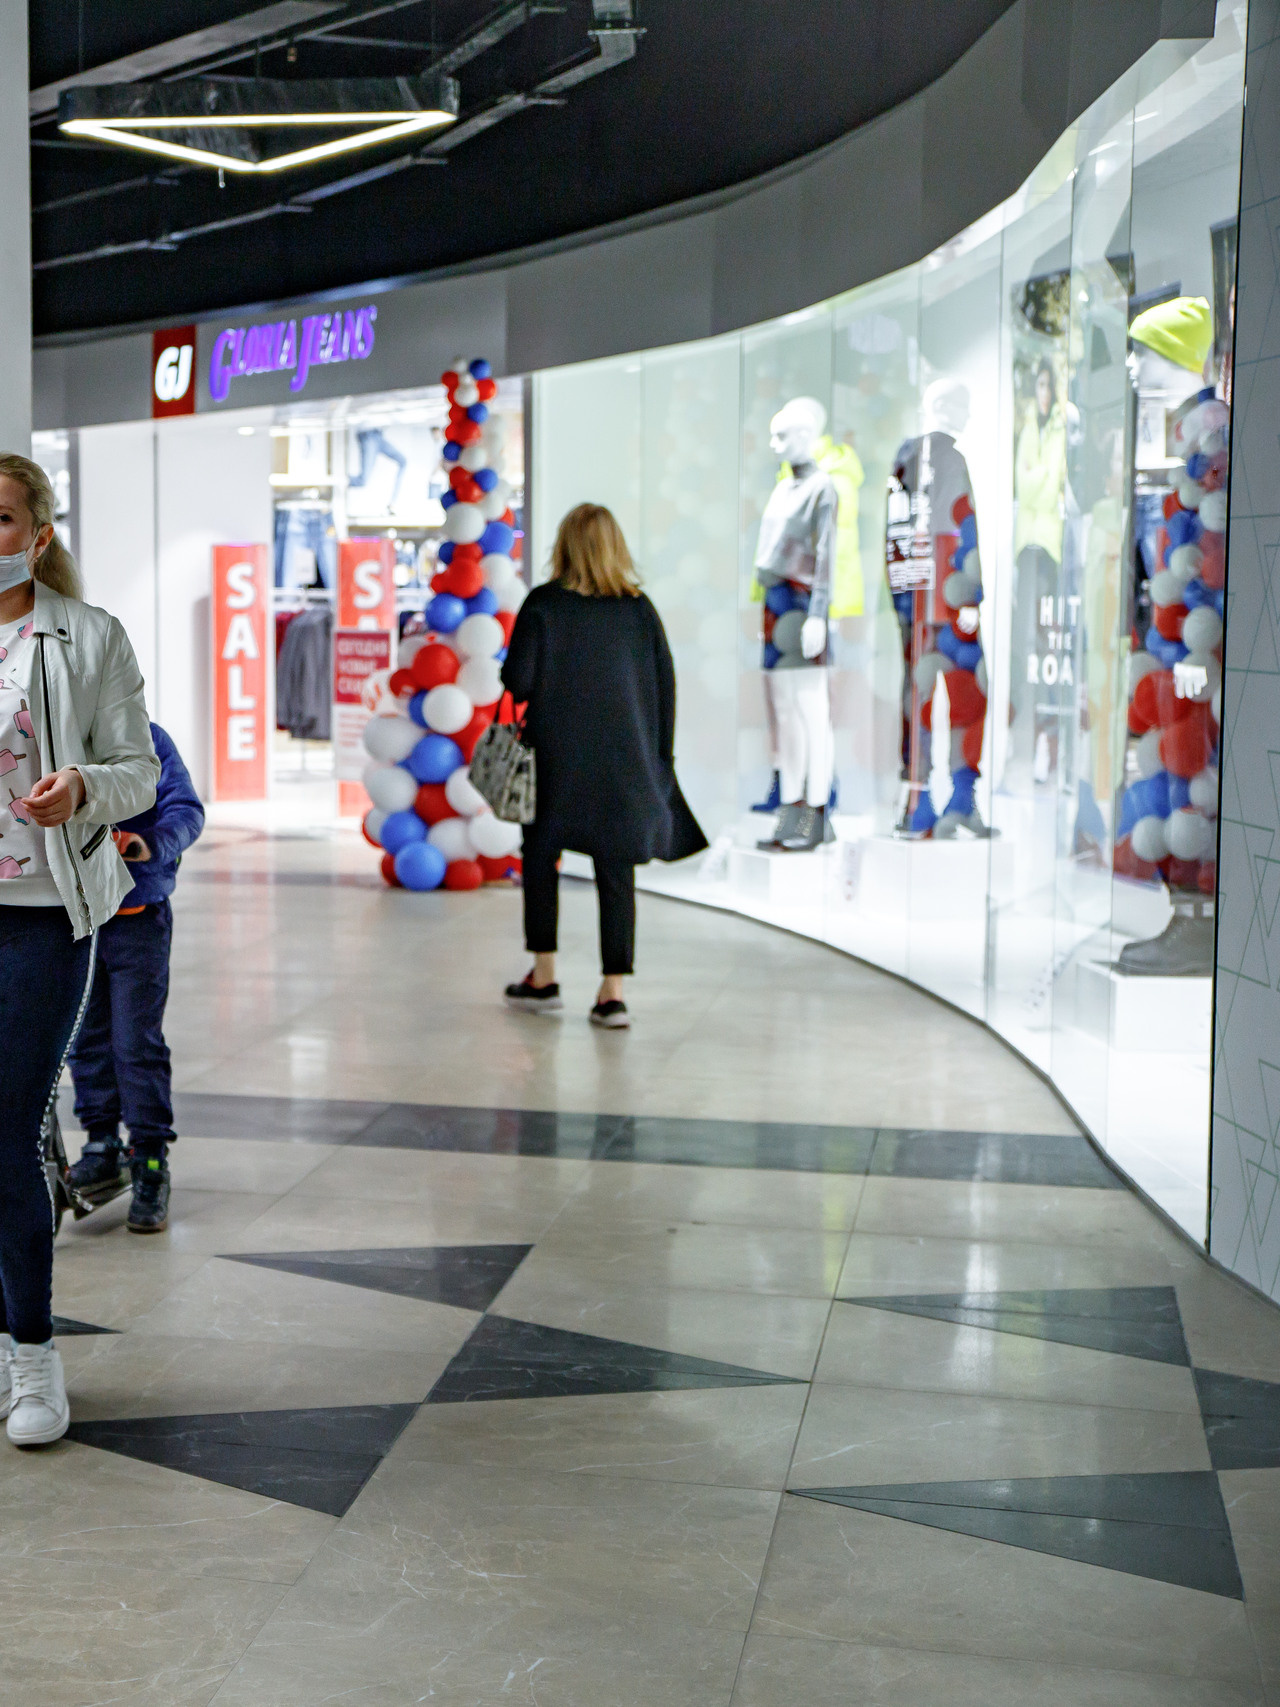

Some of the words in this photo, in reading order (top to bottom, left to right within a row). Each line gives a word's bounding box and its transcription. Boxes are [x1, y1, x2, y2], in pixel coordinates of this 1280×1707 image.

[154, 344, 194, 402] GJ
[289, 304, 378, 393] JEANS
[1039, 595, 1082, 627] HIT
[222, 562, 260, 761] SALE
